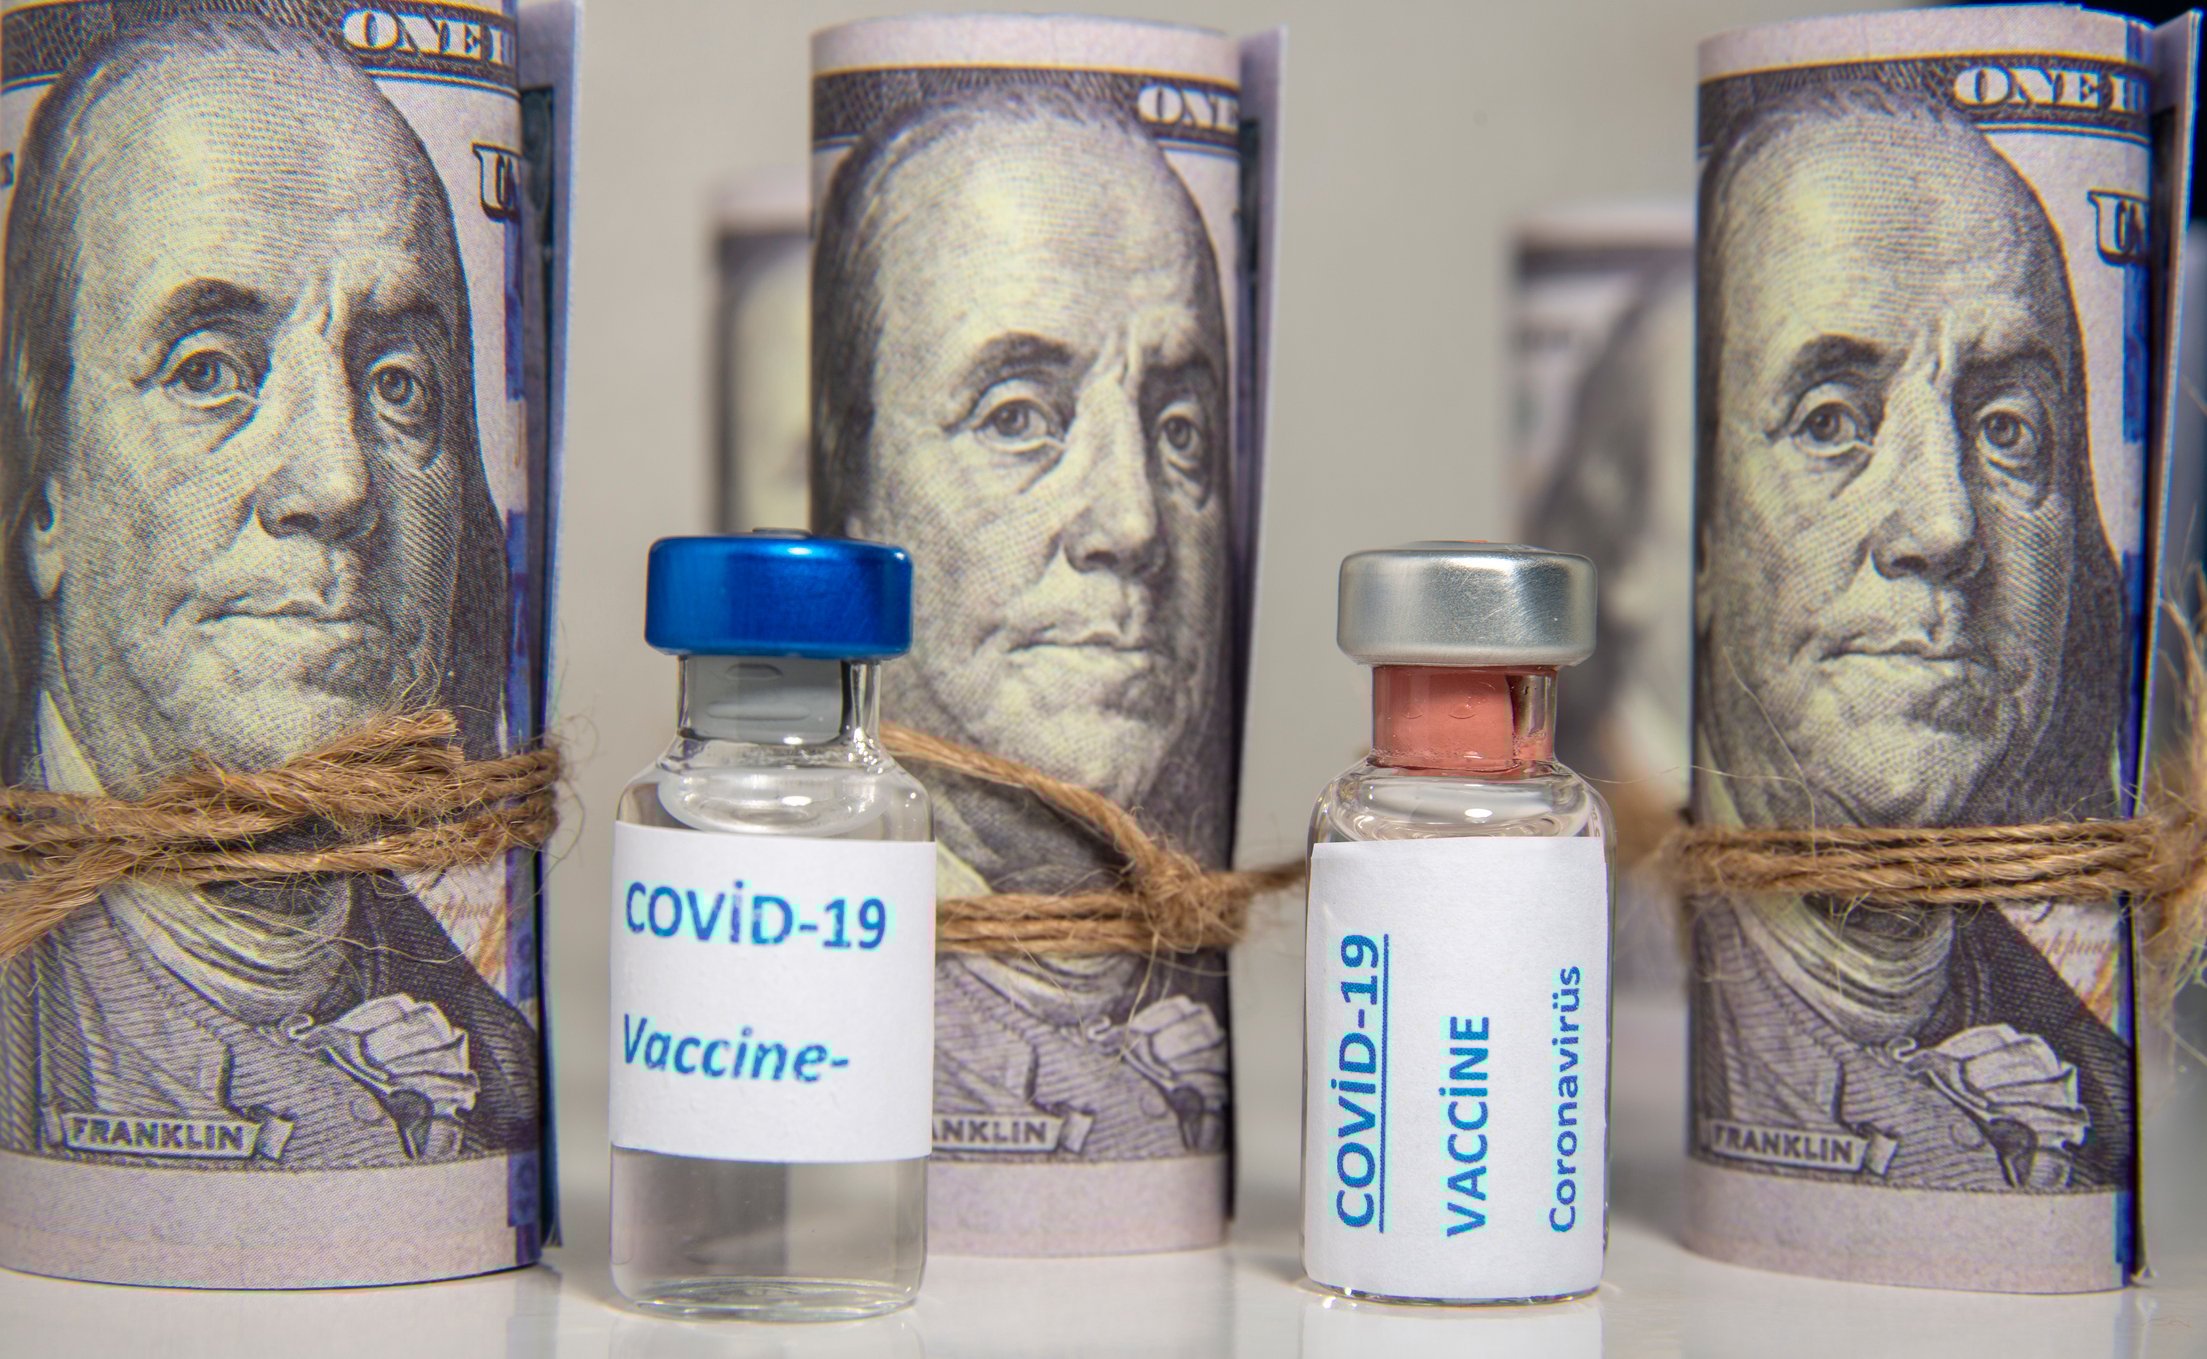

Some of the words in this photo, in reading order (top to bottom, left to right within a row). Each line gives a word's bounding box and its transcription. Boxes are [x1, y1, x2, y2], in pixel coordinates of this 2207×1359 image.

[1549, 965, 1582, 1233] Coronavirüs
[68, 1117, 244, 1150] FRANKLIN
[932, 1119, 1047, 1143] NKLIN
[1714, 1125, 1852, 1164] FRANKLIN
